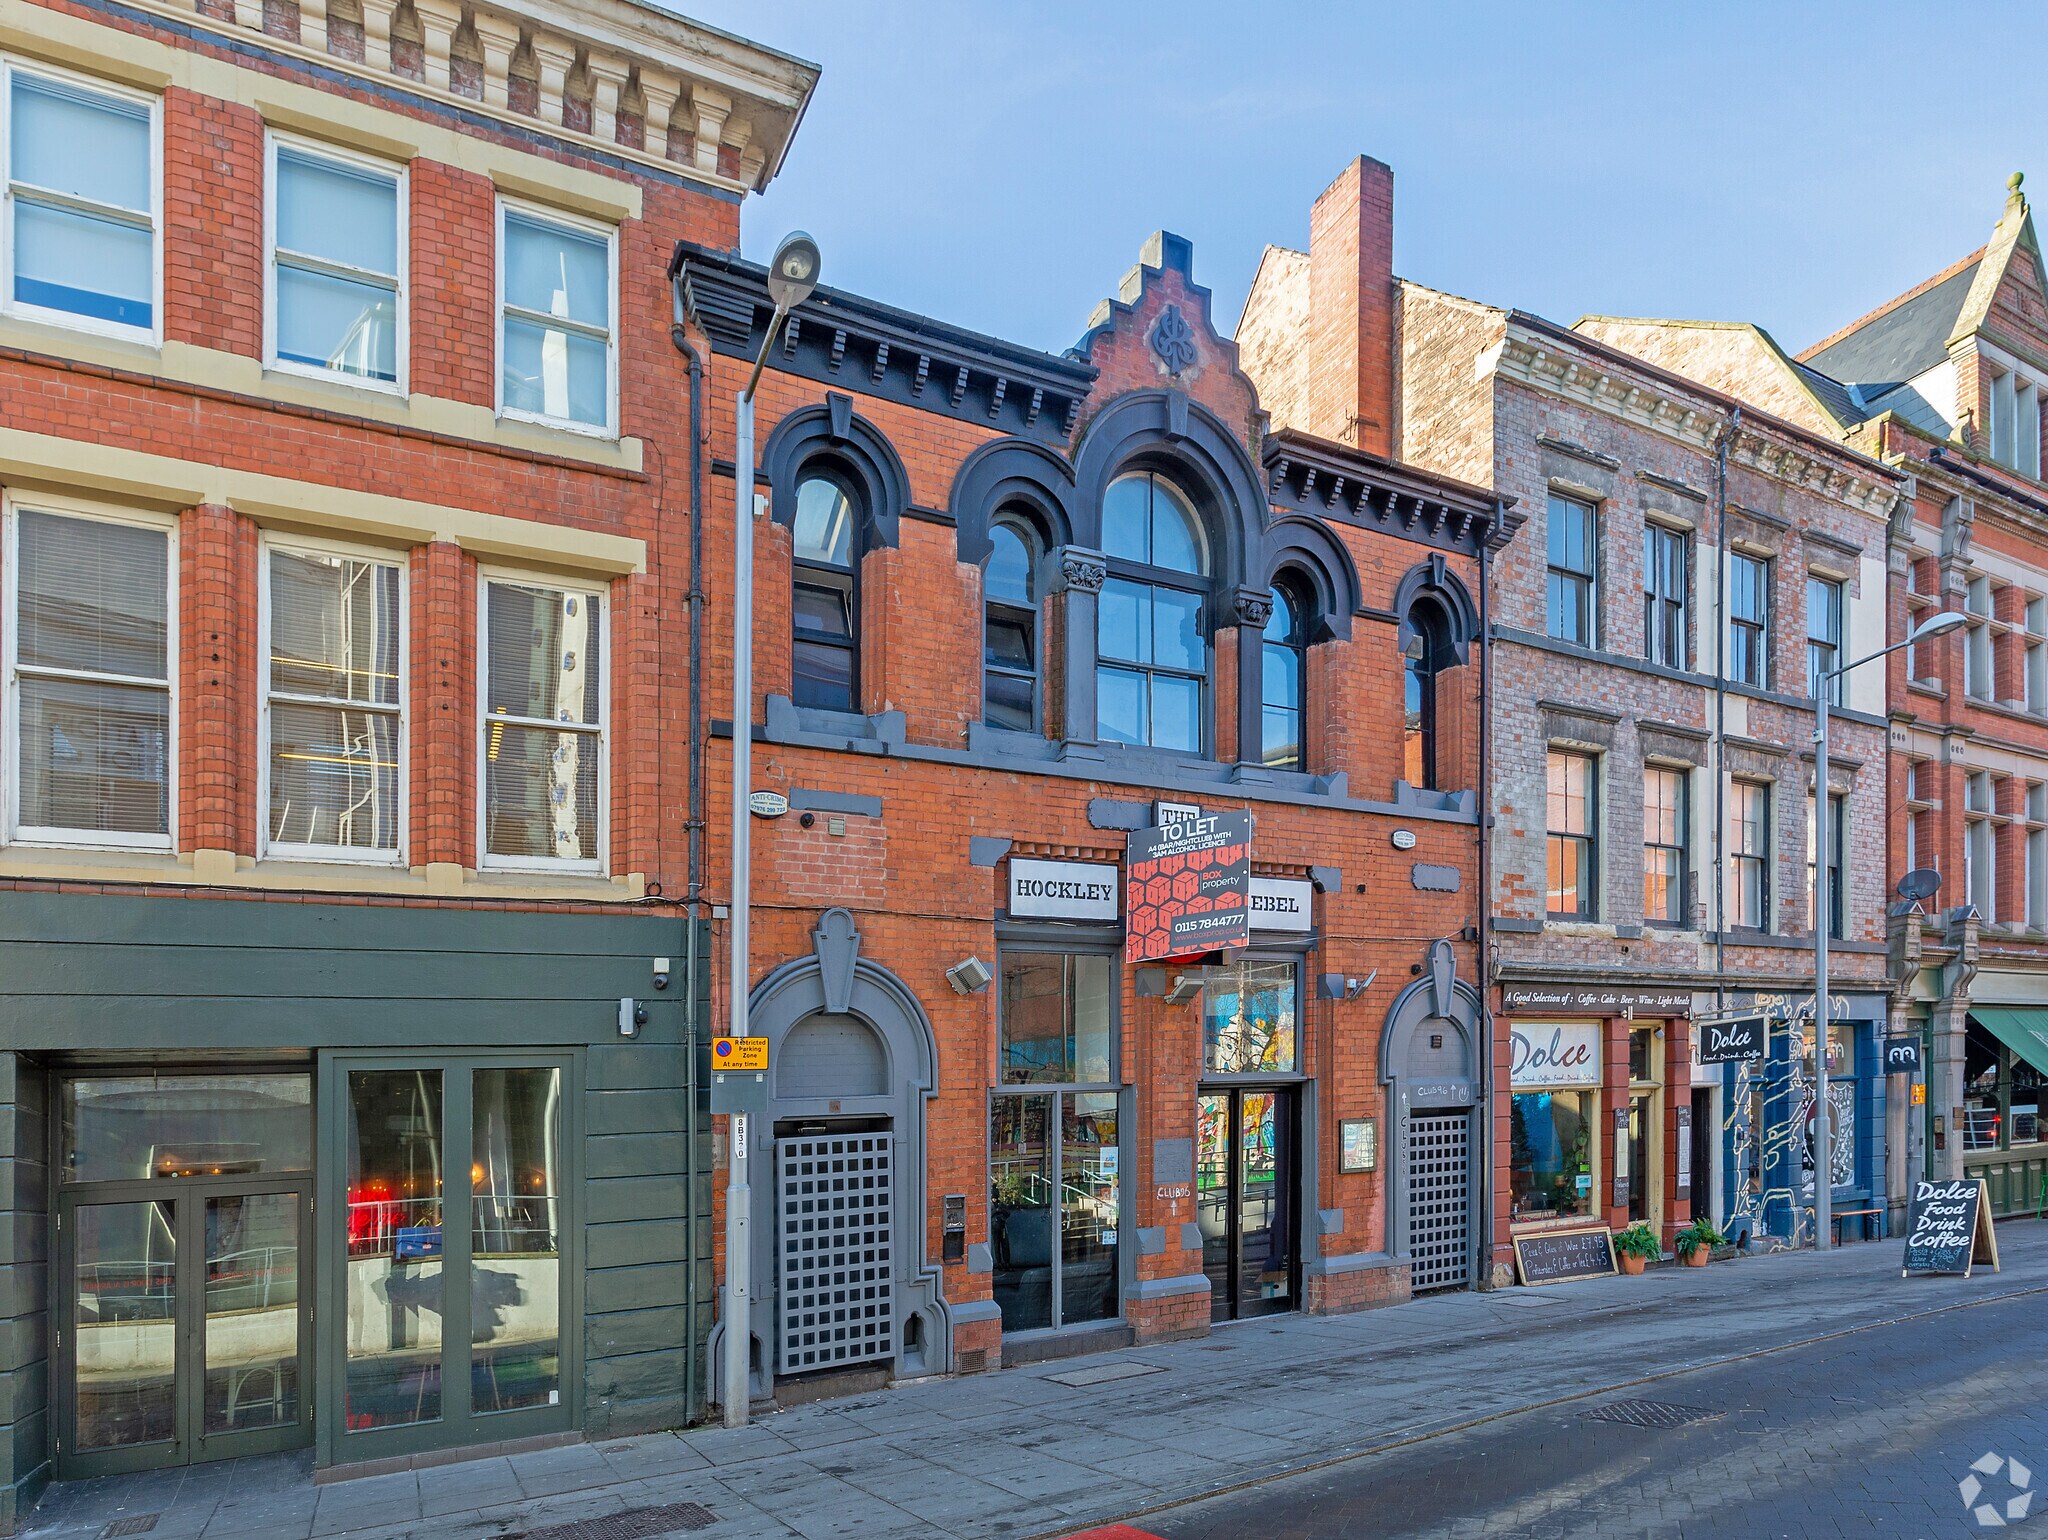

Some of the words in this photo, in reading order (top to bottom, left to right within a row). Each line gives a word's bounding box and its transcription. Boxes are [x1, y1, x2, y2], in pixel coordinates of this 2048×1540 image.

[1160, 823, 1183, 842] TO
[1187, 816, 1218, 837] LET
[1213, 831, 1231, 840] WITH
[1152, 850, 1167, 858] 3AM
[1168, 845, 1197, 856] ALCOHOL
[1199, 839, 1226, 850] LICENCE
[1202, 870, 1222, 880] BOX
[1202, 876, 1240, 890] property
[1017, 879, 1113, 901] HOCKLEY
[1249, 895, 1299, 913] EBEL
[1175, 921, 1198, 933] 0115
[1199, 914, 1245, 929] 7844777
[1174, 927, 1244, 942] www.boxprop.co.uk
[1505, 992, 1511, 1001] A
[1513, 991, 1532, 1002] Good
[1532, 992, 1560, 1003] Selection
[1578, 993, 1597, 1006] Coffee
[1601, 993, 1616, 1004] Cake
[1620, 994, 1634, 1004] Beer
[1639, 995, 1654, 1004] Wine
[1657, 995, 1672, 1007] Light
[1672, 996, 1690, 1005] Meals
[1511, 1026, 1591, 1076] Dolce
[1417, 1085, 1448, 1096] CLUB96
[1157, 1186, 1191, 1199] CLUB96
[1916, 1181, 1978, 1201] Dolce
[1923, 1202, 1967, 1216] Food
[1916, 1215, 1966, 1231] Drink
[1581, 1236, 1604, 1250] £7.95
[1909, 1231, 1970, 1248] Coffee
[1584, 1251, 1607, 1268] £4.45
